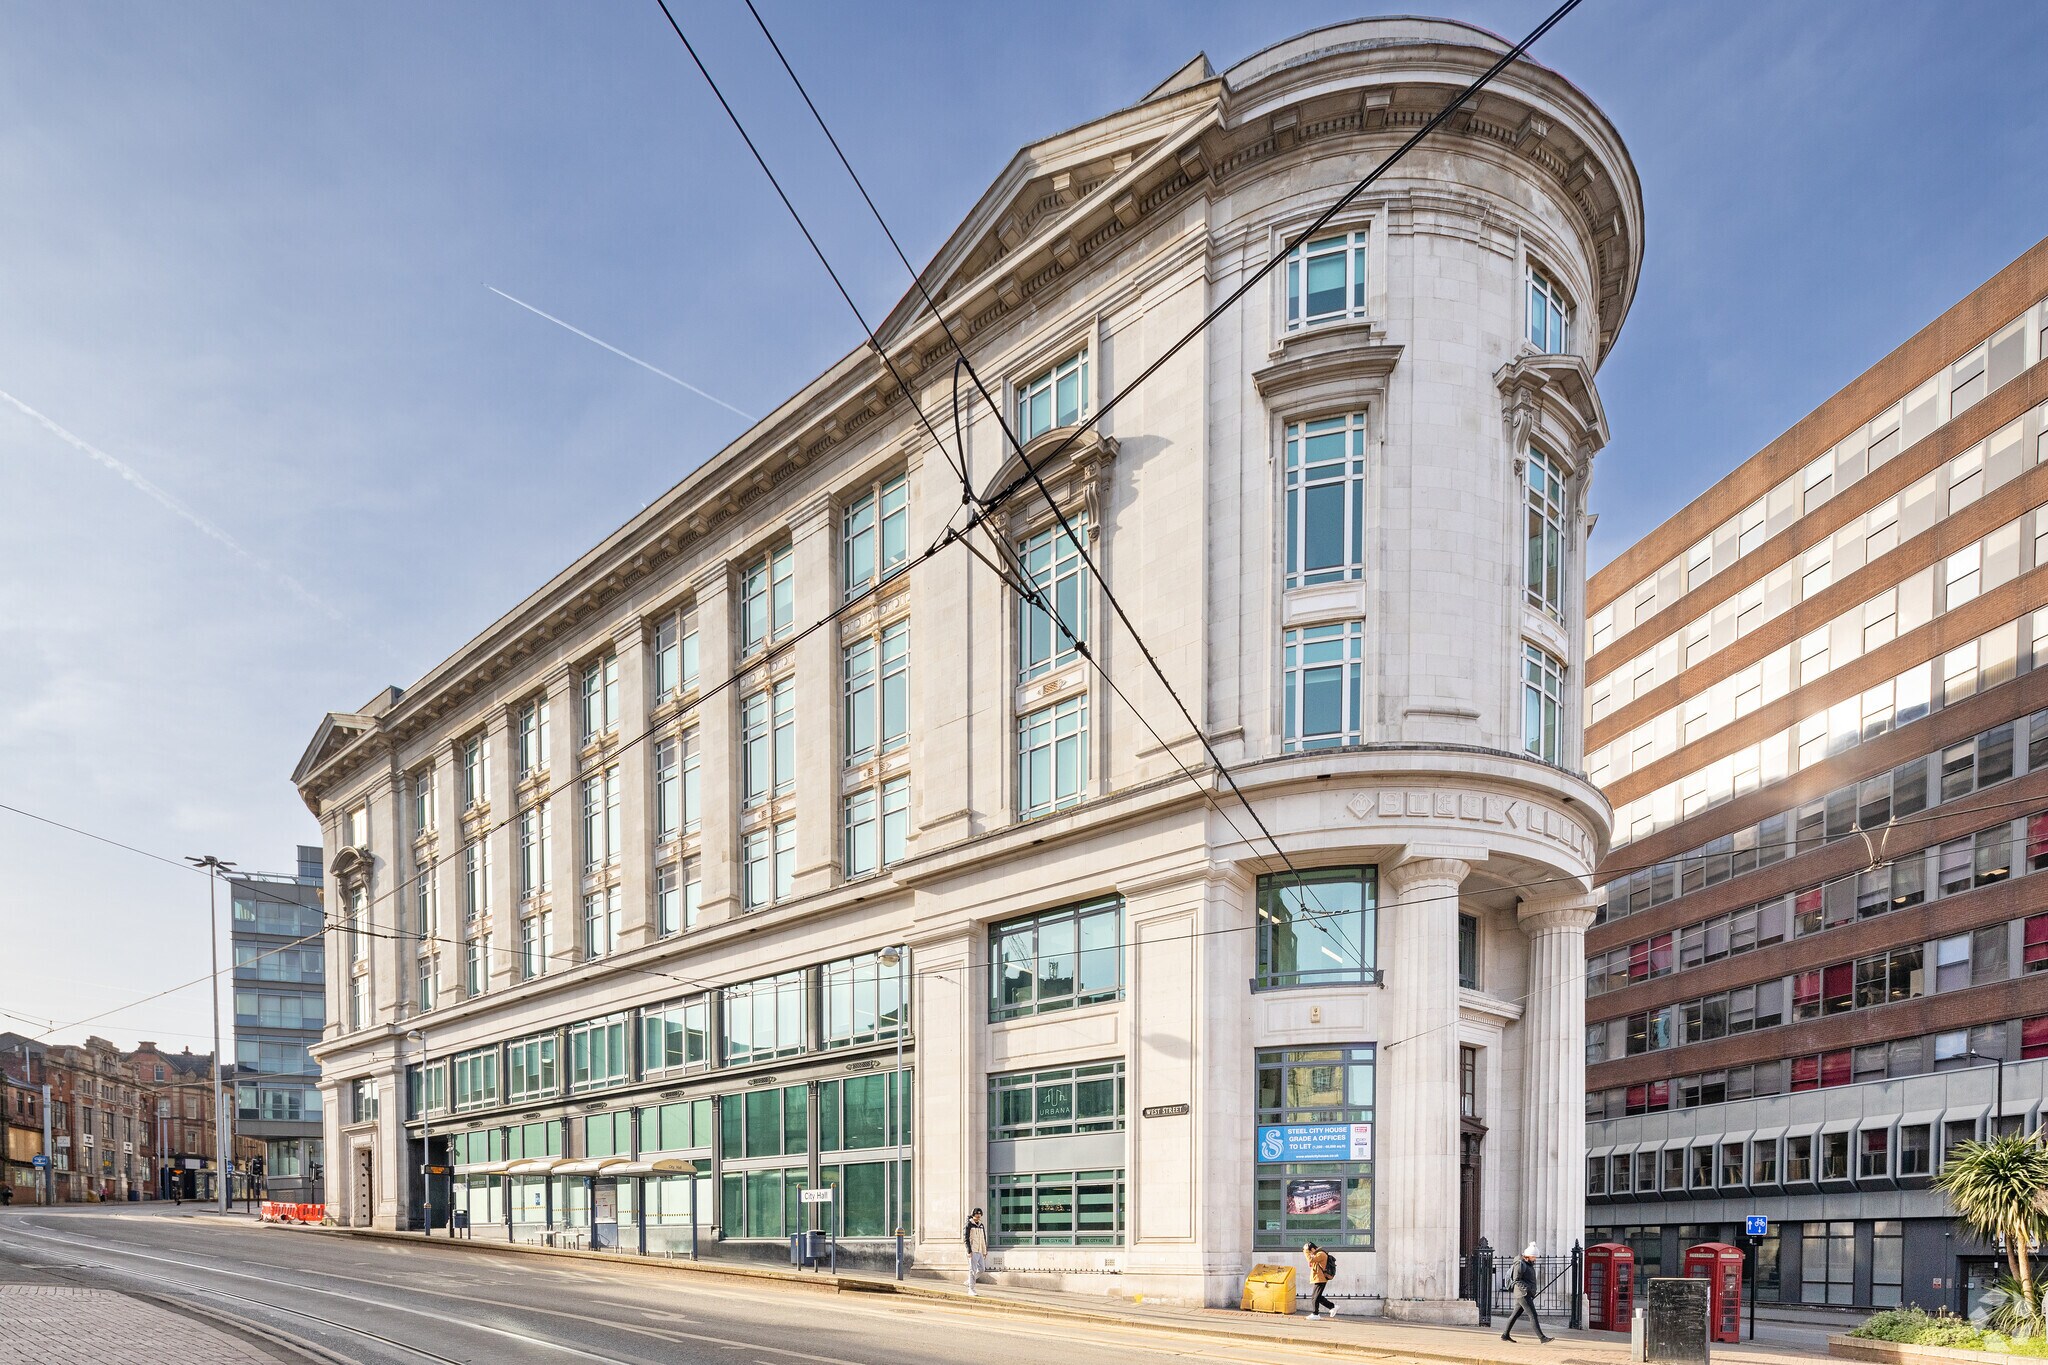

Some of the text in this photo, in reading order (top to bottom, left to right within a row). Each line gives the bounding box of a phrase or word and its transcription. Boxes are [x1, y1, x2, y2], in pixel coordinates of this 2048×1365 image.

[1039, 1107, 1070, 1116] URBANA
[1162, 1106, 1182, 1114] STREET
[804, 1191, 828, 1200] City Hall
